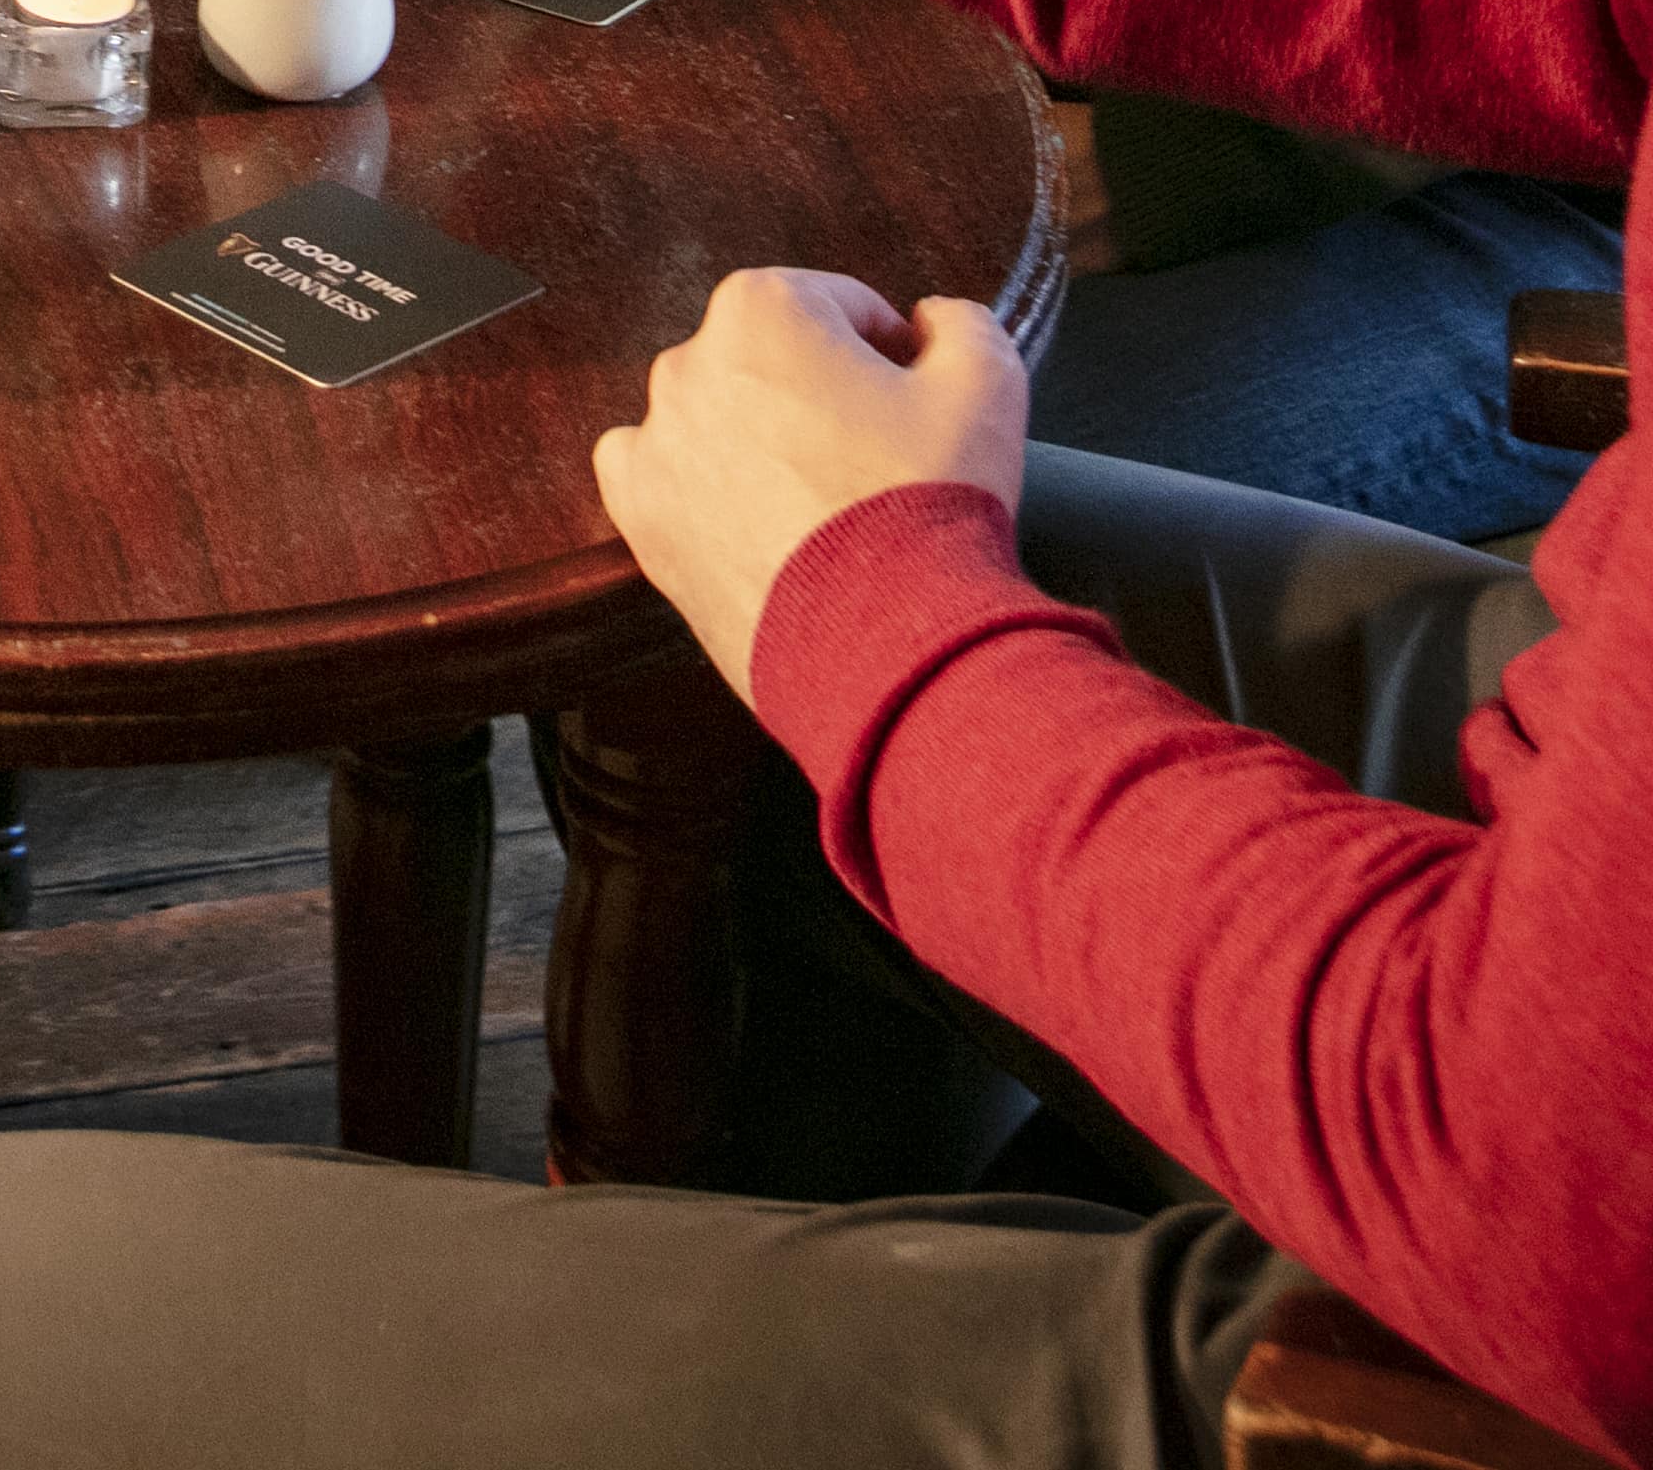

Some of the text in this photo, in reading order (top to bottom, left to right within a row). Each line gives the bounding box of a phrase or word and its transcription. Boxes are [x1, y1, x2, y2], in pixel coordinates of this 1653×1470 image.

[243, 251, 381, 322] GUINNESS
[280, 235, 358, 274] GOOD
[355, 269, 419, 305] TIME
